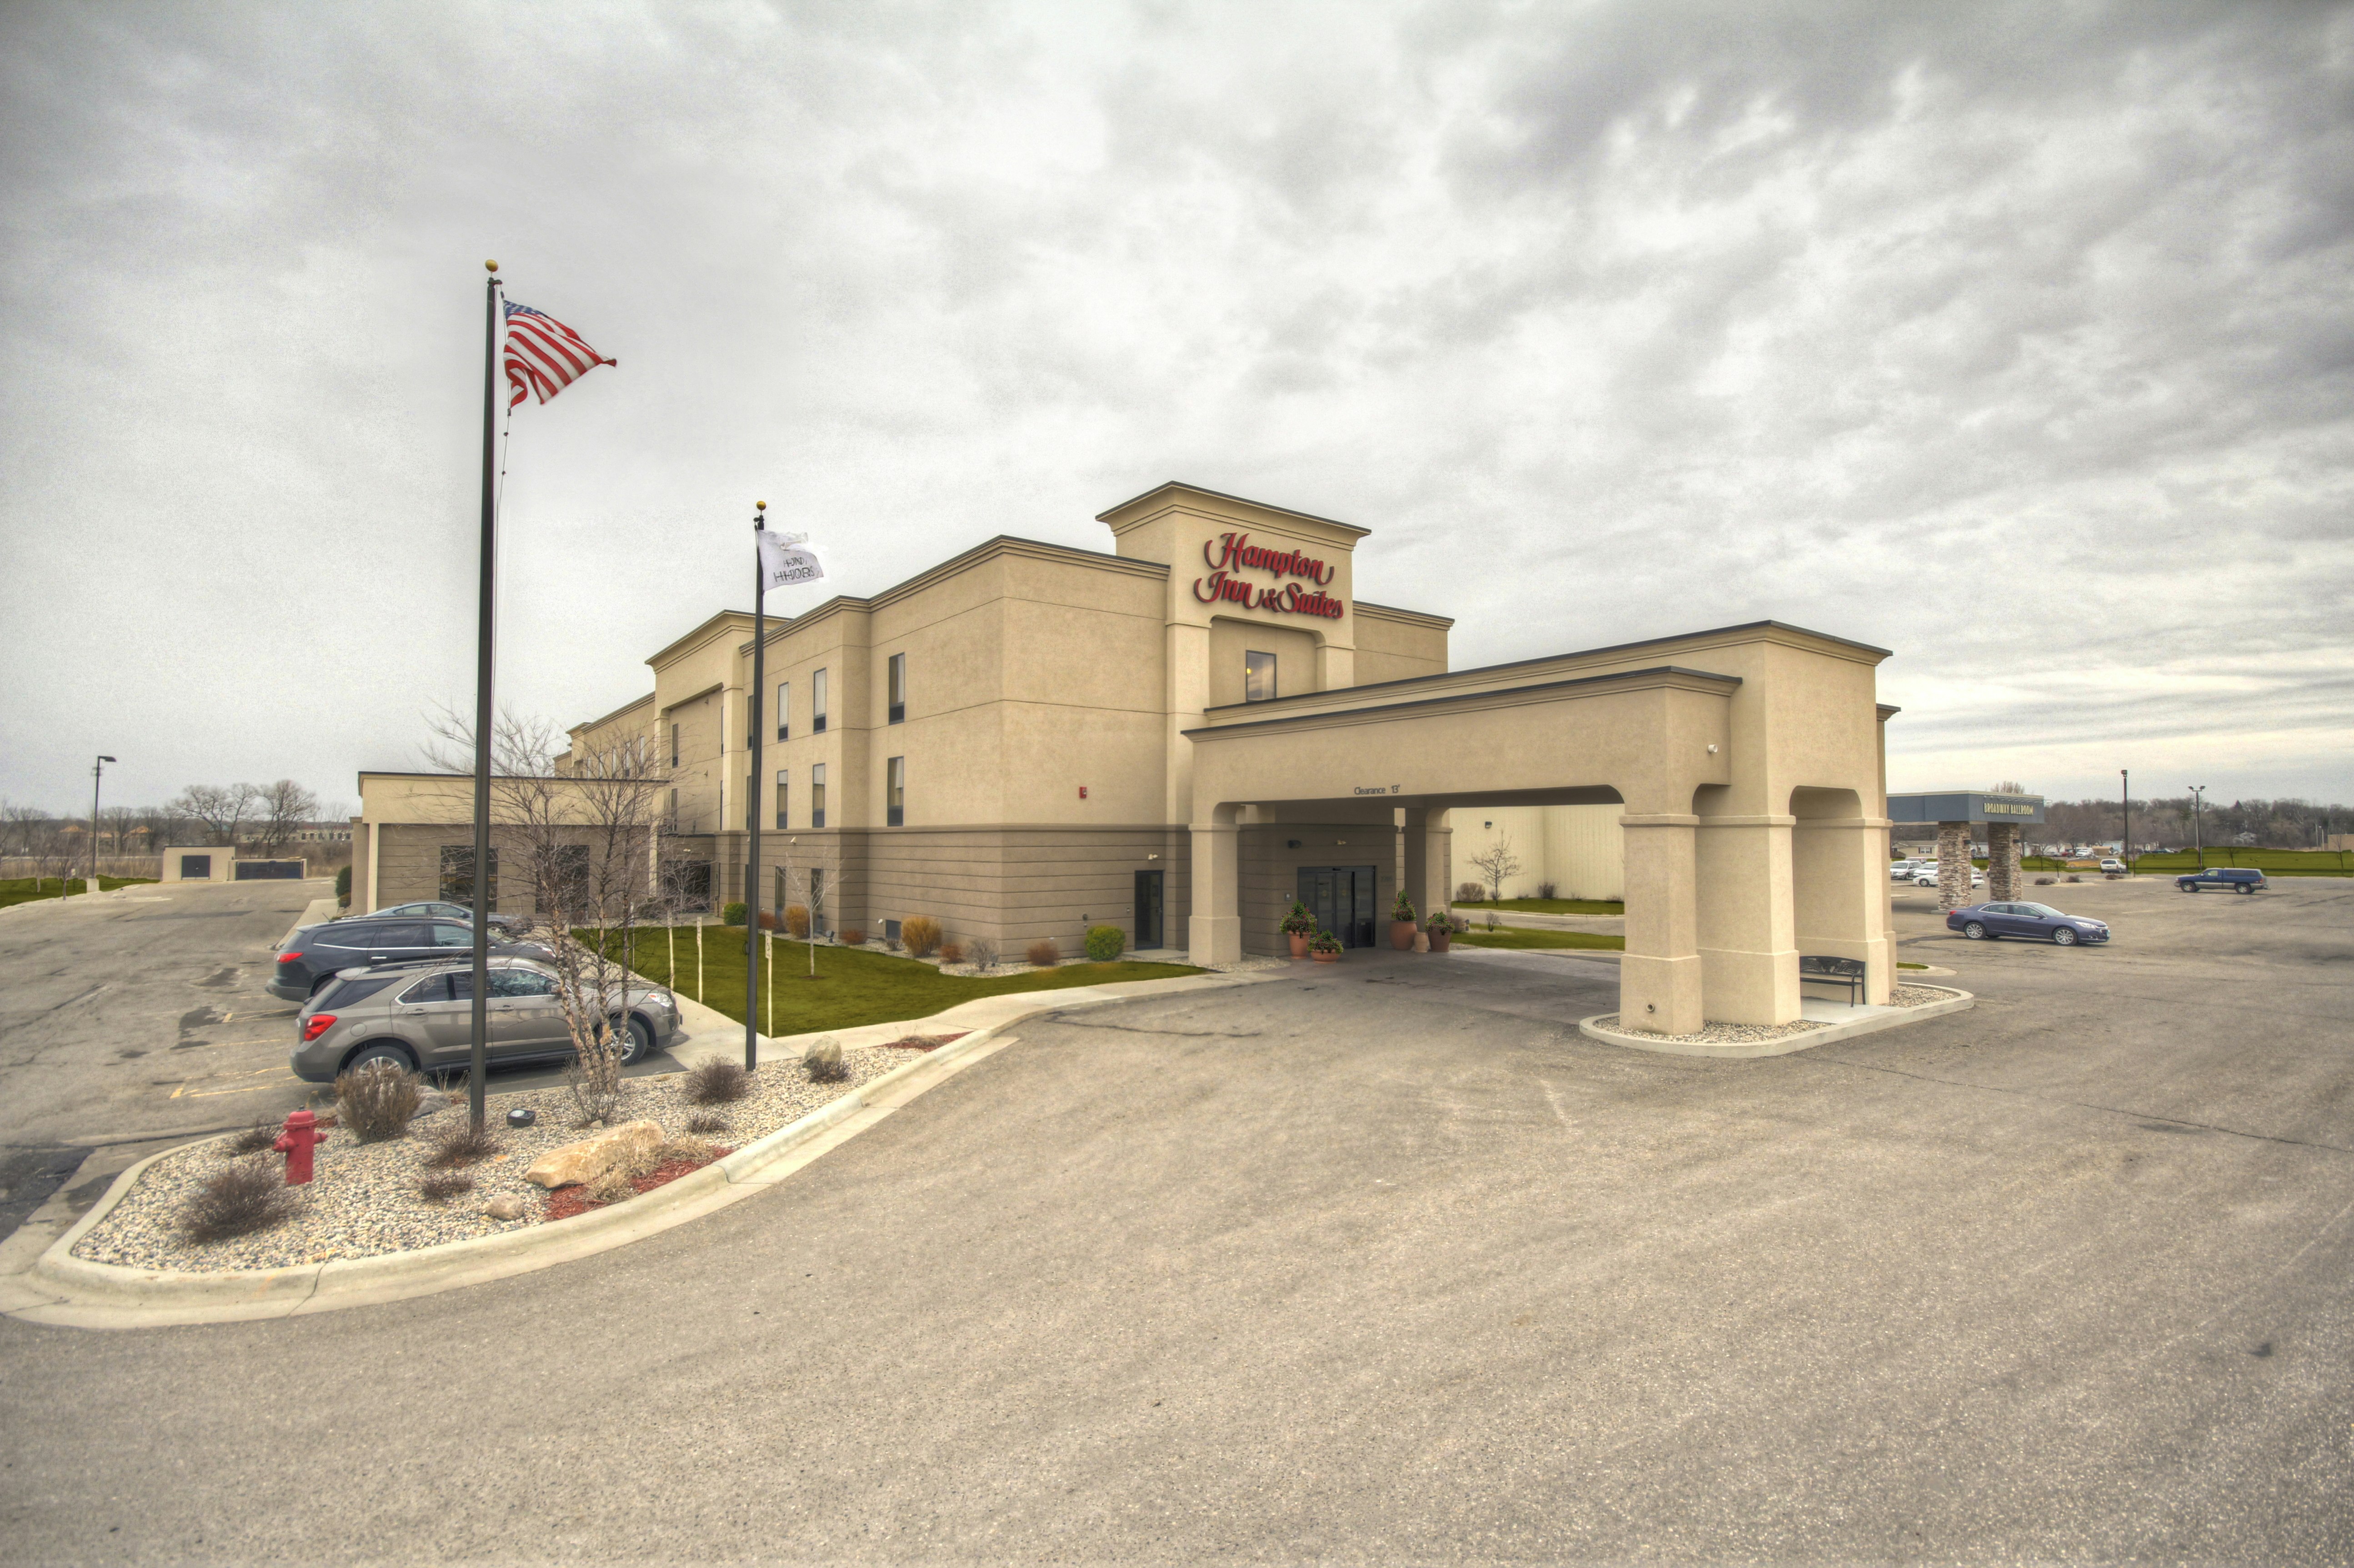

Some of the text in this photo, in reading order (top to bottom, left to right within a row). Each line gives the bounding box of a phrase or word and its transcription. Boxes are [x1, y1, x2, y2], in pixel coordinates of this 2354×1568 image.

[1204, 532, 1334, 585] Hampton
[1193, 571, 1344, 619] Inn & Suites
[1354, 787, 1386, 795] Clearance
[1983, 803, 2033, 816] BROADWAY BALLROOM
